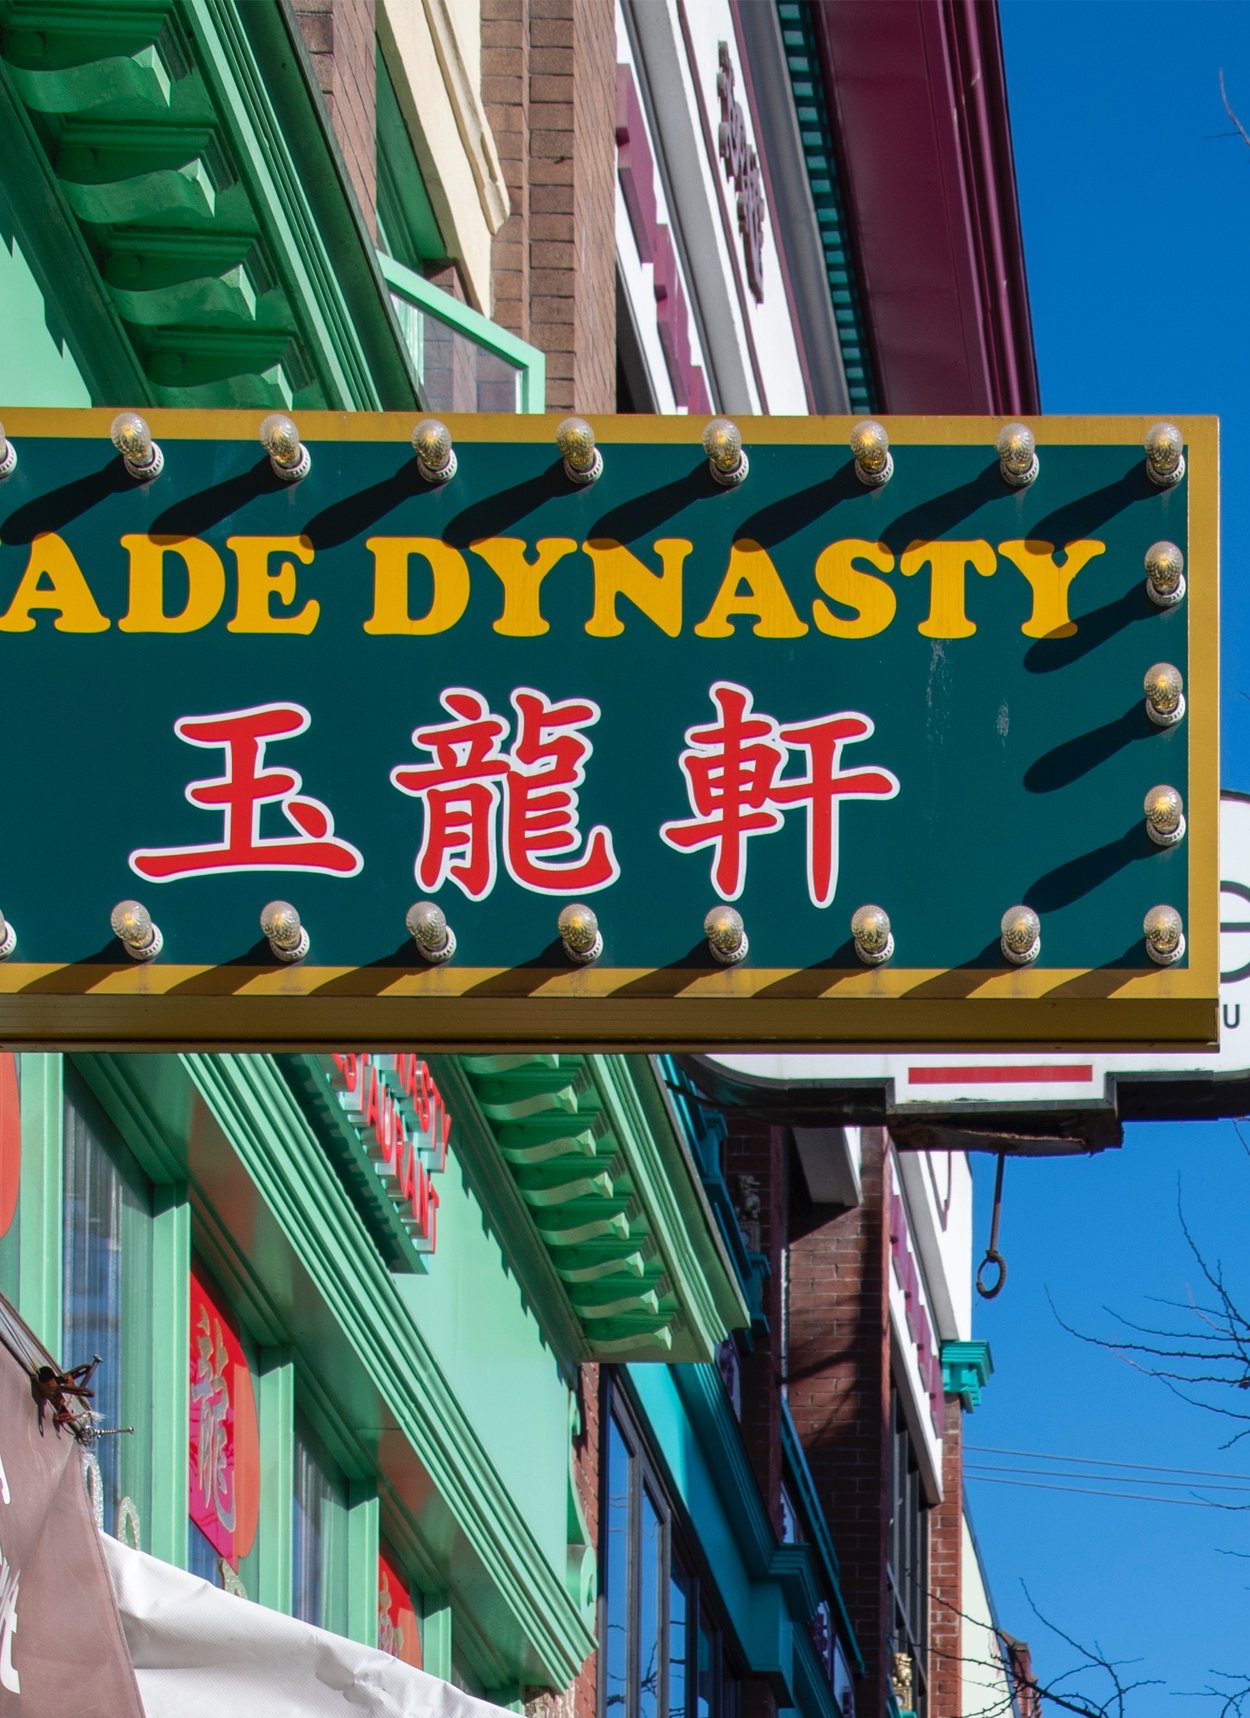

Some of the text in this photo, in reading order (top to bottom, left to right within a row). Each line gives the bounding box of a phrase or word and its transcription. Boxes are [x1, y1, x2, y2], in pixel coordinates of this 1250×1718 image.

[363, 533, 1107, 641] DYNASTY
[127, 681, 902, 908] 玉龍軒
